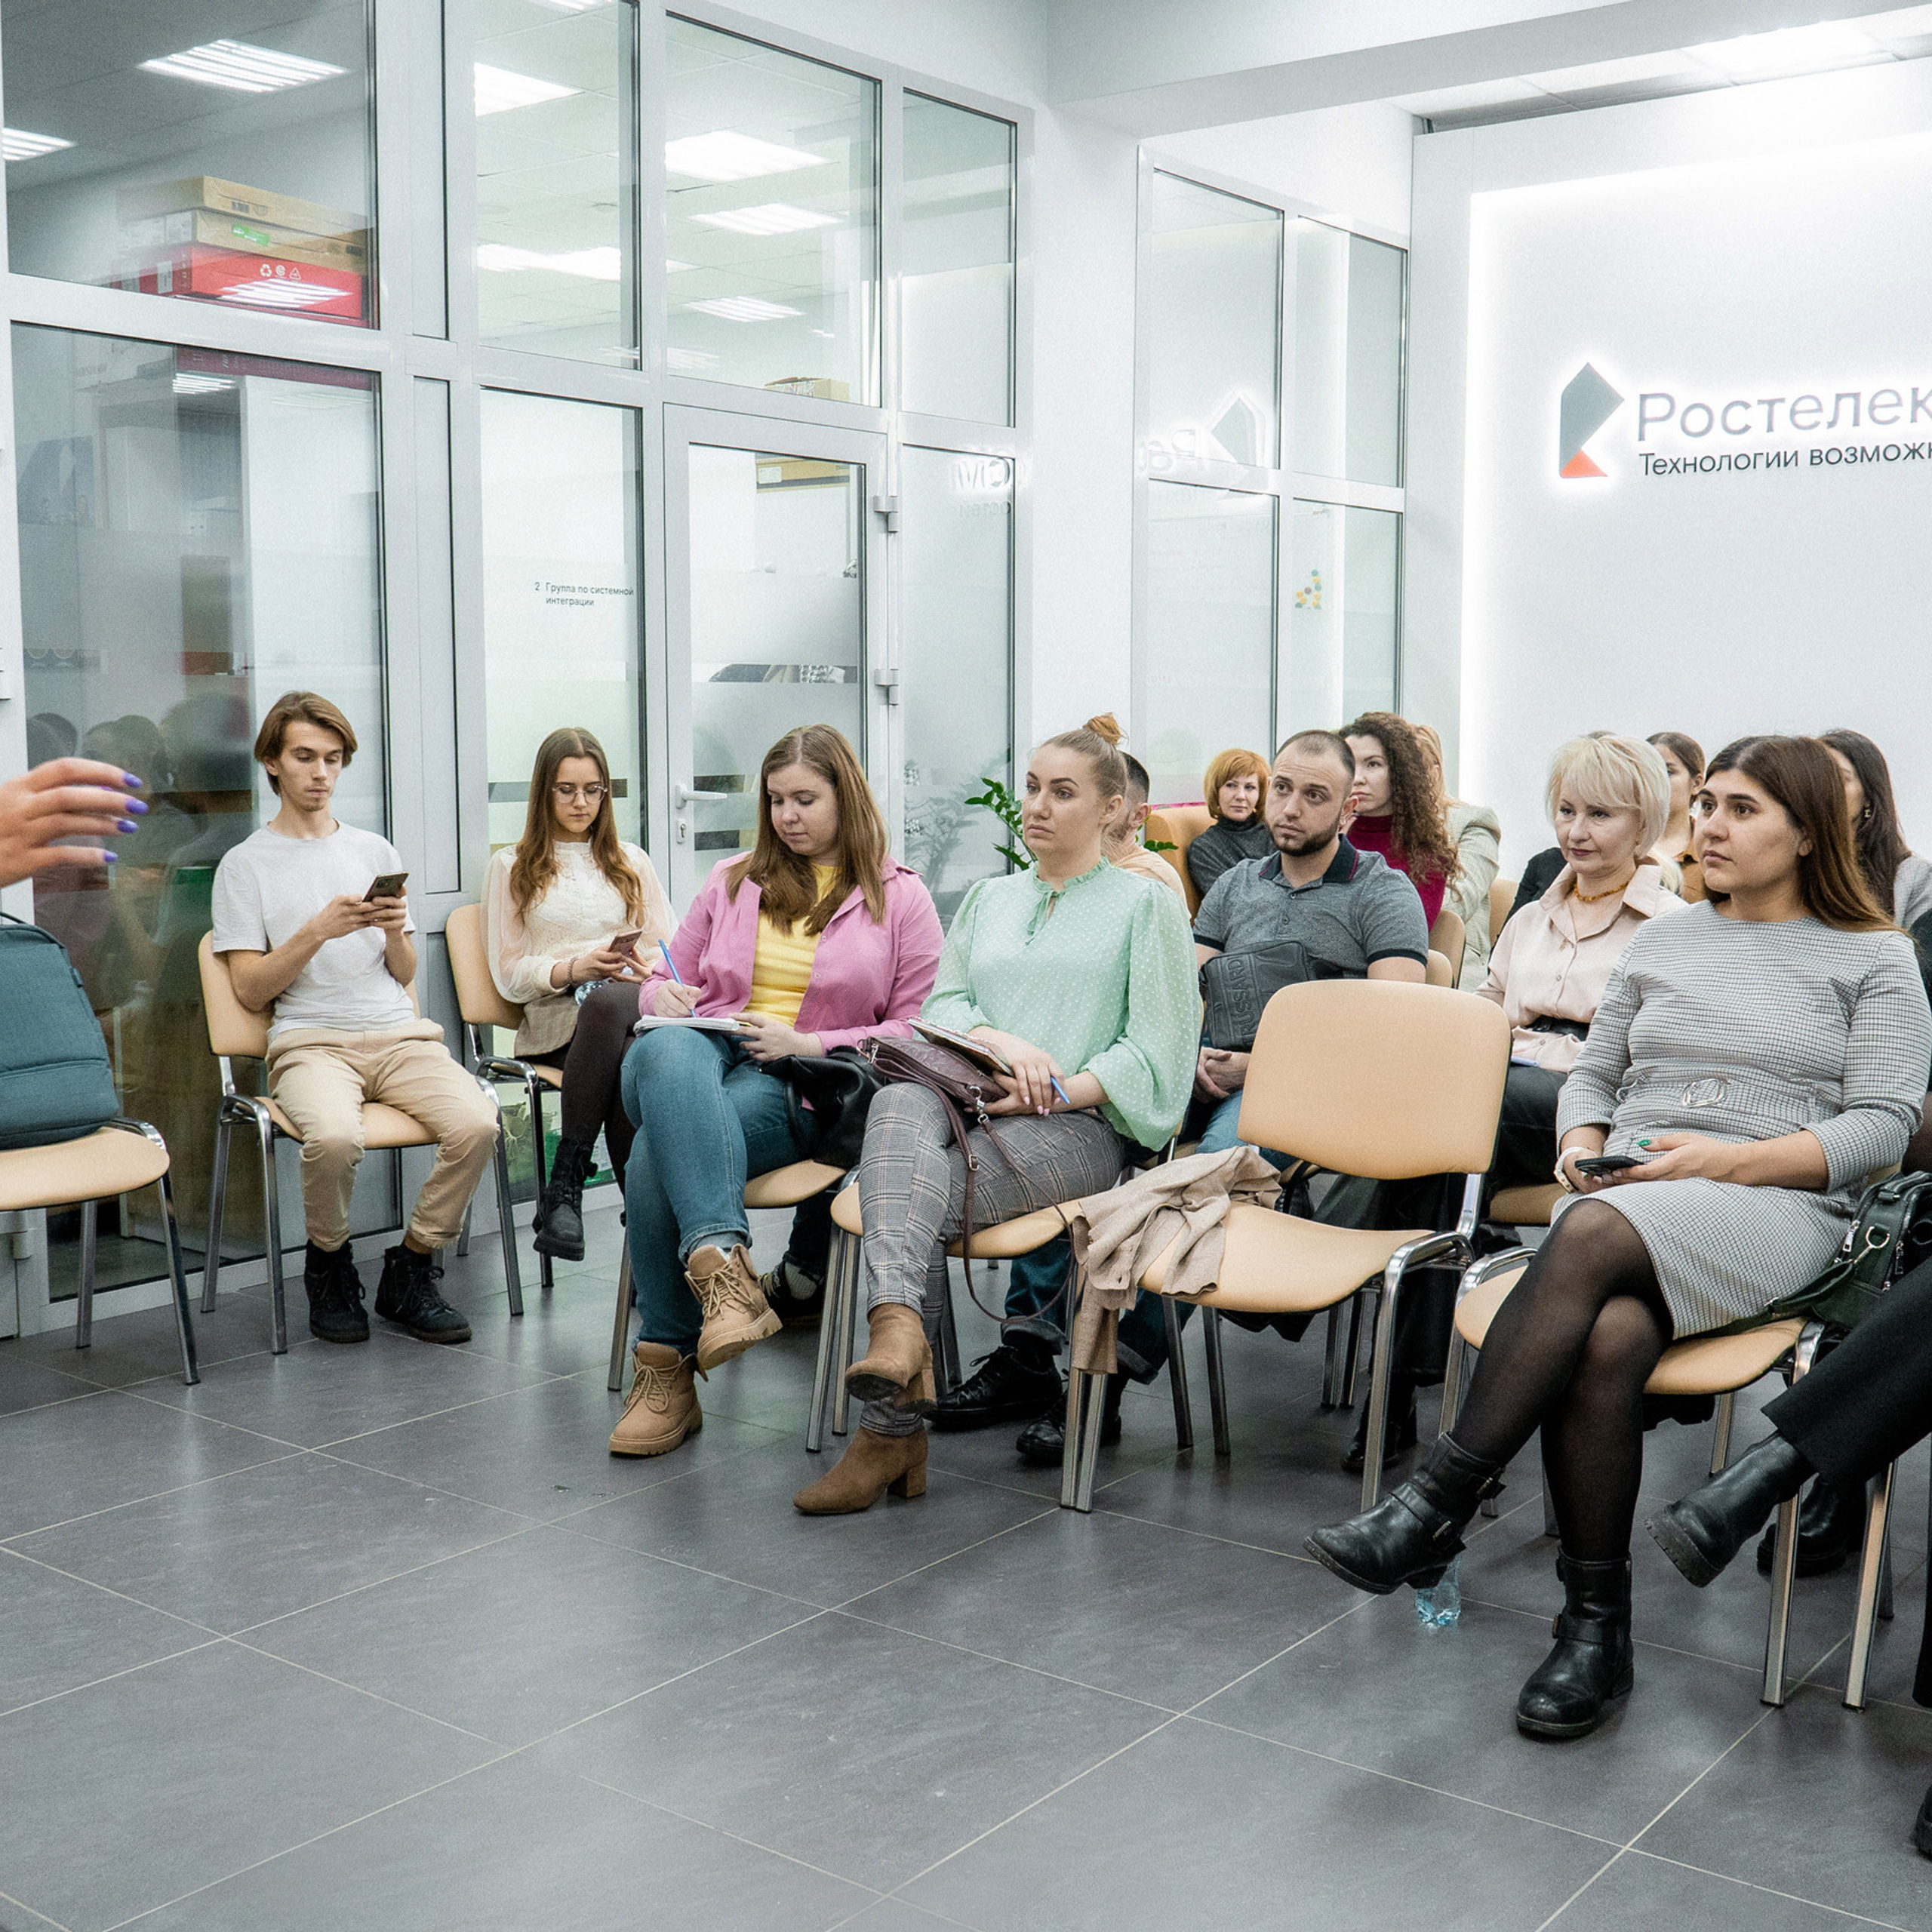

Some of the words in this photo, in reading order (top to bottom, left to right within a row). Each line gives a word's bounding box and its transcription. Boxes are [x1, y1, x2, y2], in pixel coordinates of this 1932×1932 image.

[1638, 386, 1932, 441] Ростелек
[1639, 451, 1799, 475] Технологии
[534, 582, 540, 591] 2
[546, 582, 576, 595] Группа
[578, 585, 588, 594] по
[590, 586, 634, 595] системной
[546, 597, 594, 607] интеграции
